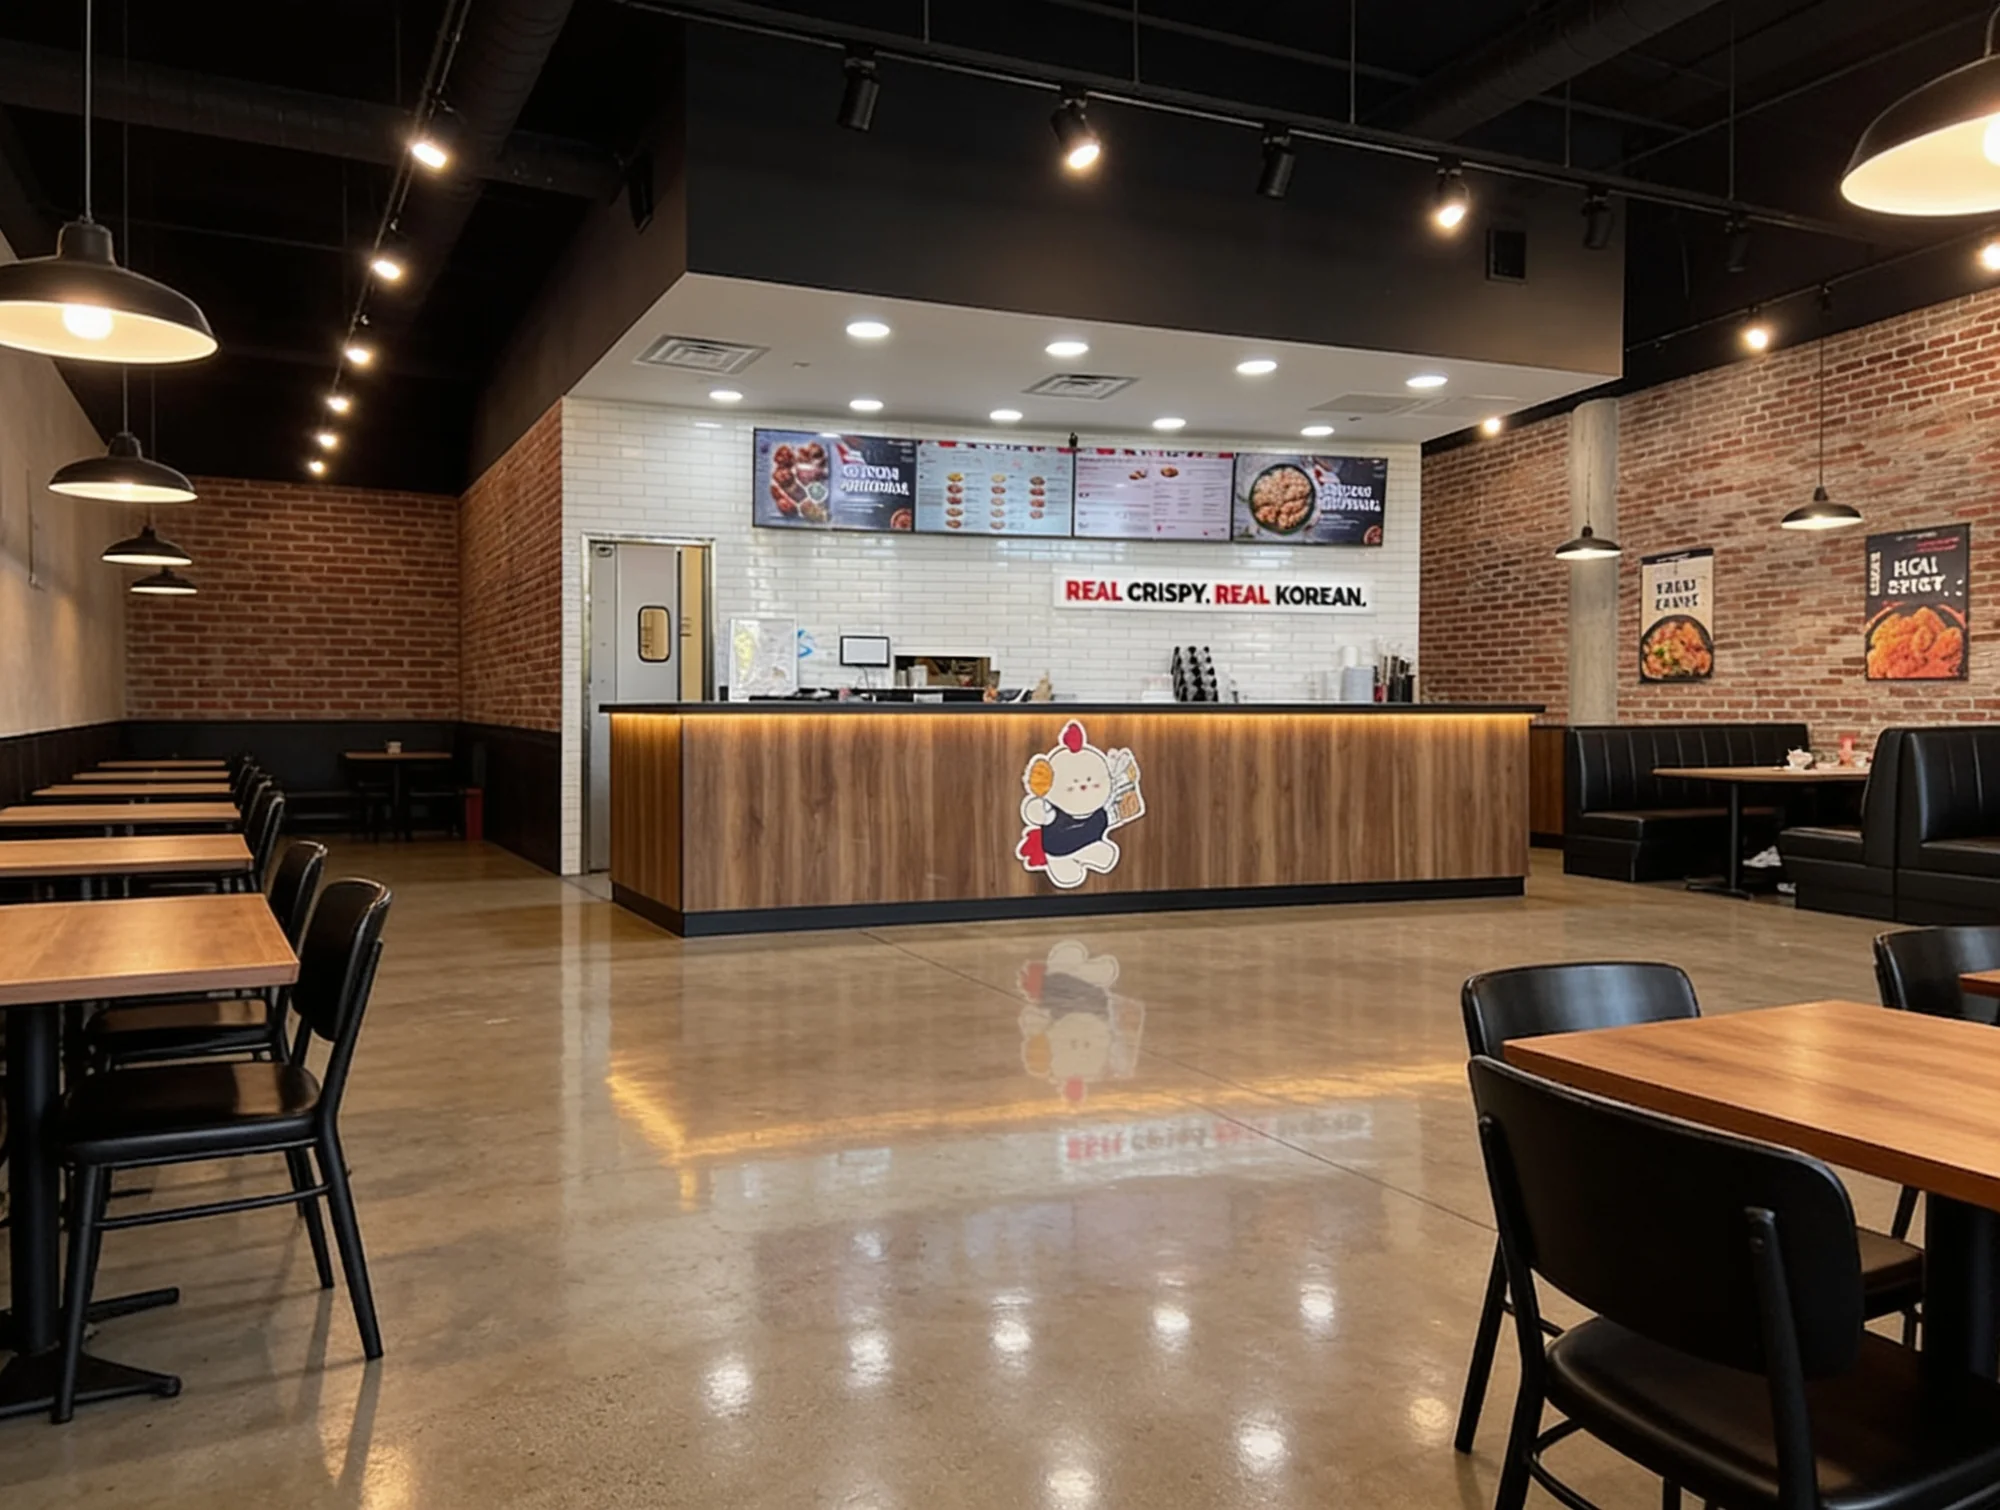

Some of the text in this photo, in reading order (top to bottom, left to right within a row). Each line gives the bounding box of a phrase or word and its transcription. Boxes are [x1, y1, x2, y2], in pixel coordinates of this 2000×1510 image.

[1066, 580, 1367, 607] REAL CRISPY. REAL KOREAN.
